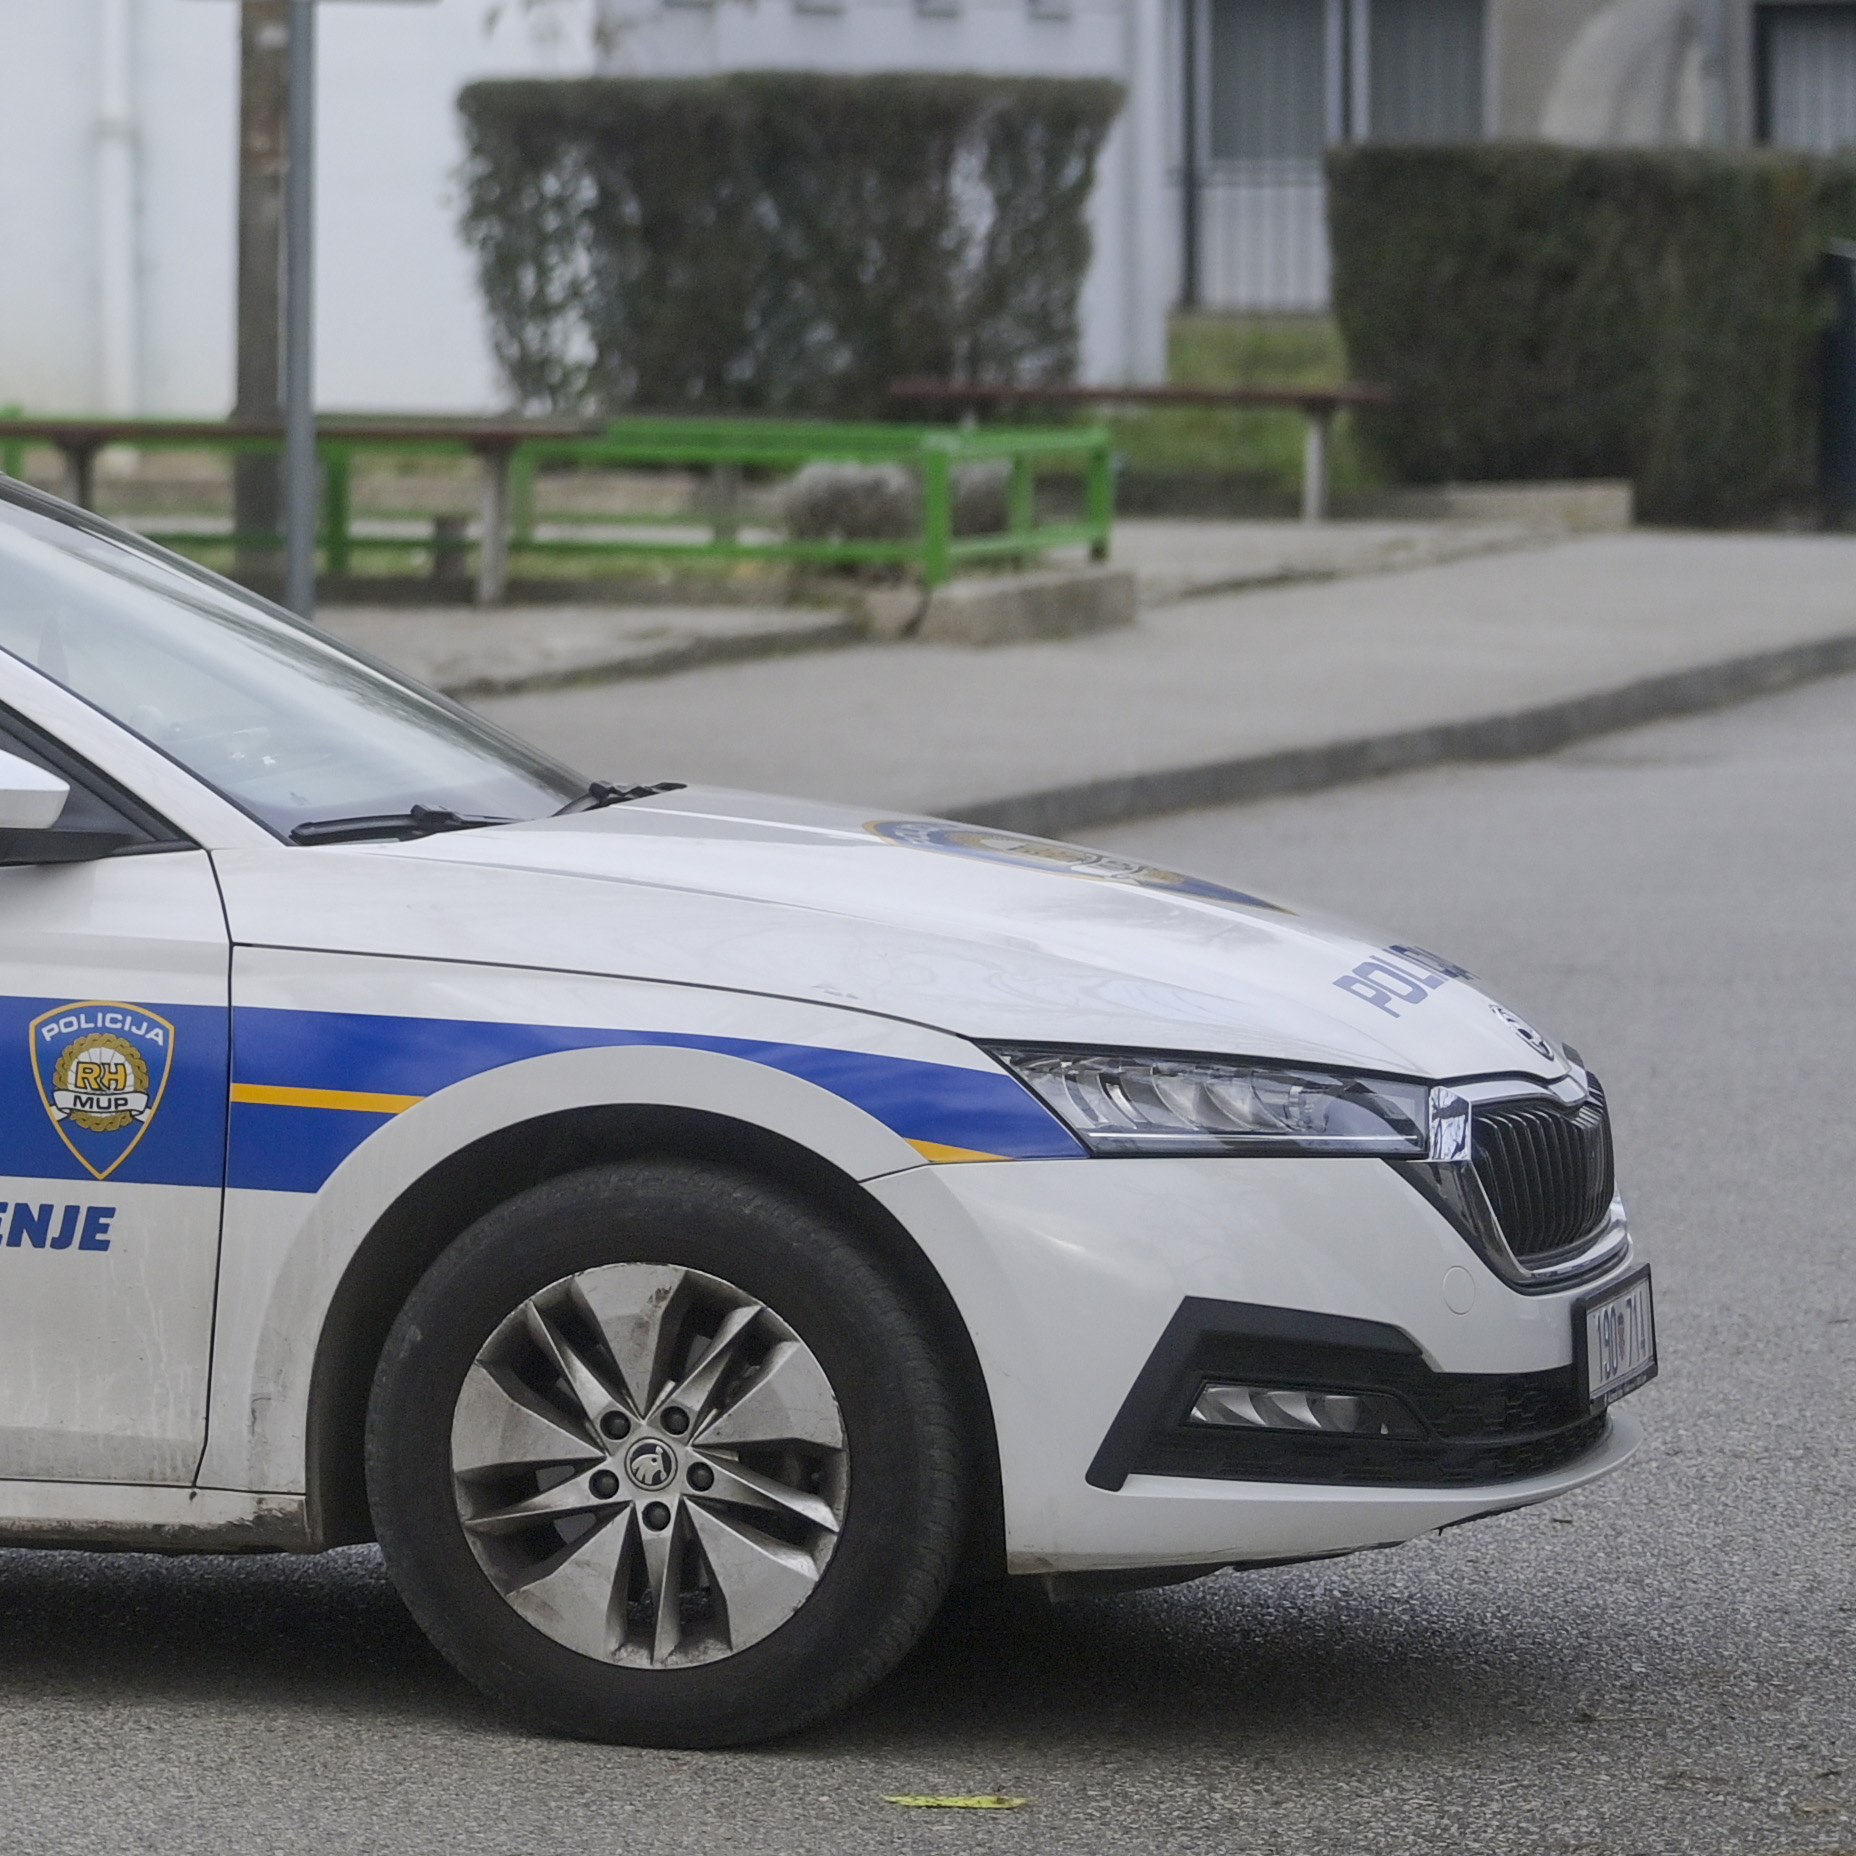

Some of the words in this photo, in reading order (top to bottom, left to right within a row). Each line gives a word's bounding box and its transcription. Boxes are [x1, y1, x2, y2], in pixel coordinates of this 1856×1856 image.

[1332, 943, 1482, 1019] POLIC
[41, 1013, 164, 1046] POLICIJA
[75, 1062, 128, 1091] RH
[72, 1094, 129, 1111] MUP
[1597, 1305, 1618, 1382] 190
